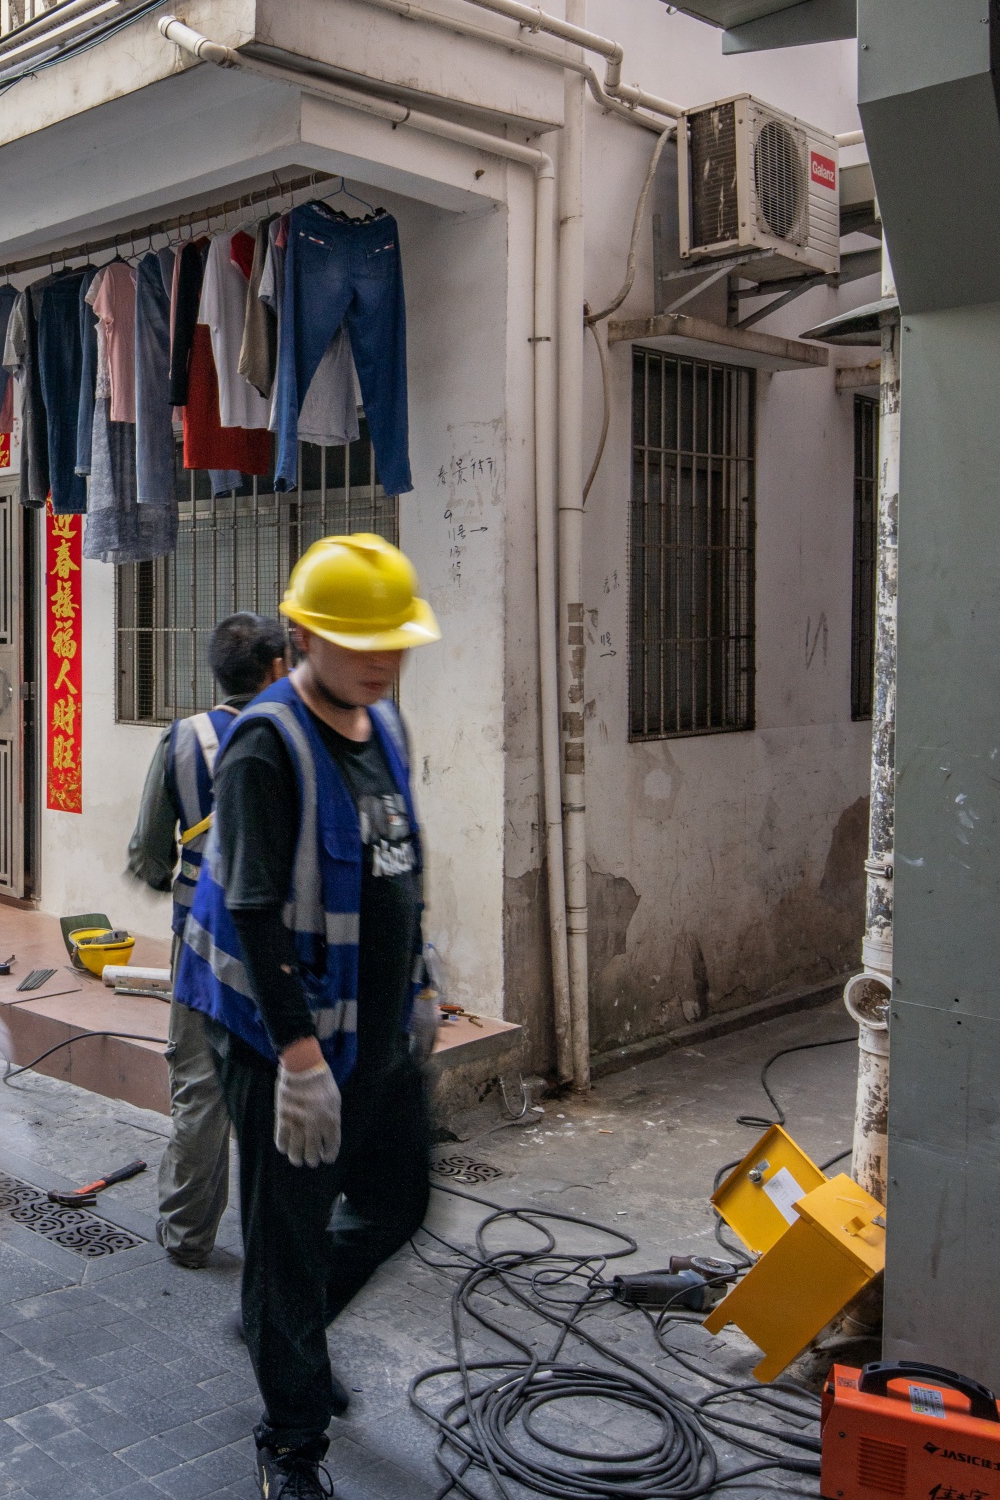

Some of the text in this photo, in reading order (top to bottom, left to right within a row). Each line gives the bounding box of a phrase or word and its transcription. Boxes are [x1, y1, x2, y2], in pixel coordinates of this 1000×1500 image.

[812, 161, 834, 182] Galanz
[444, 509, 453, 523] 9
[448, 524, 466, 541] 11号
[450, 546, 461, 557] 13
[452, 561, 461, 570] 15
